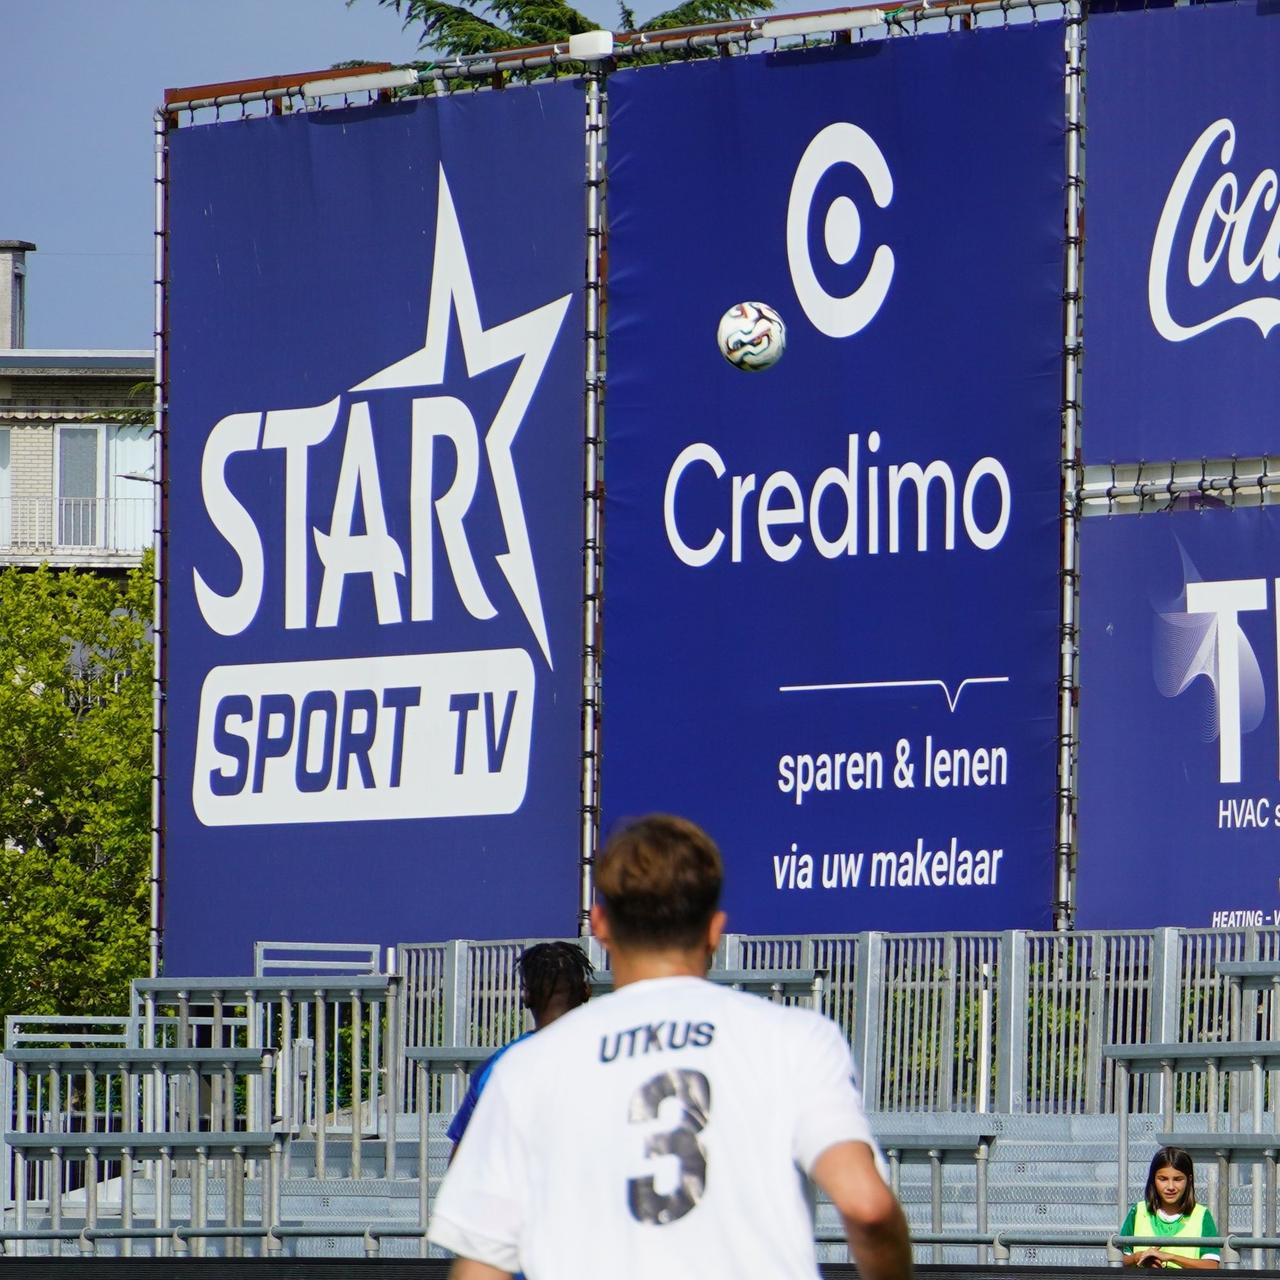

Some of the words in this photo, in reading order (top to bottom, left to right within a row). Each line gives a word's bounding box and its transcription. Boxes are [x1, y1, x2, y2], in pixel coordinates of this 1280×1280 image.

[192, 395, 498, 637] STAR
[664, 431, 1010, 566] Credimo
[209, 686, 420, 797] SPORT
[448, 689, 517, 775] TV
[779, 752, 882, 804] sparen
[894, 739, 914, 788] &
[925, 736, 1007, 787] lenen
[1219, 798, 1269, 828] HVAC
[774, 843, 814, 889] via
[822, 854, 863, 888] uw
[871, 838, 1002, 886] makelaar
[1212, 910, 1263, 928] HEATING
[598, 1021, 716, 1064] UTKUS
[627, 1068, 713, 1226] 3
